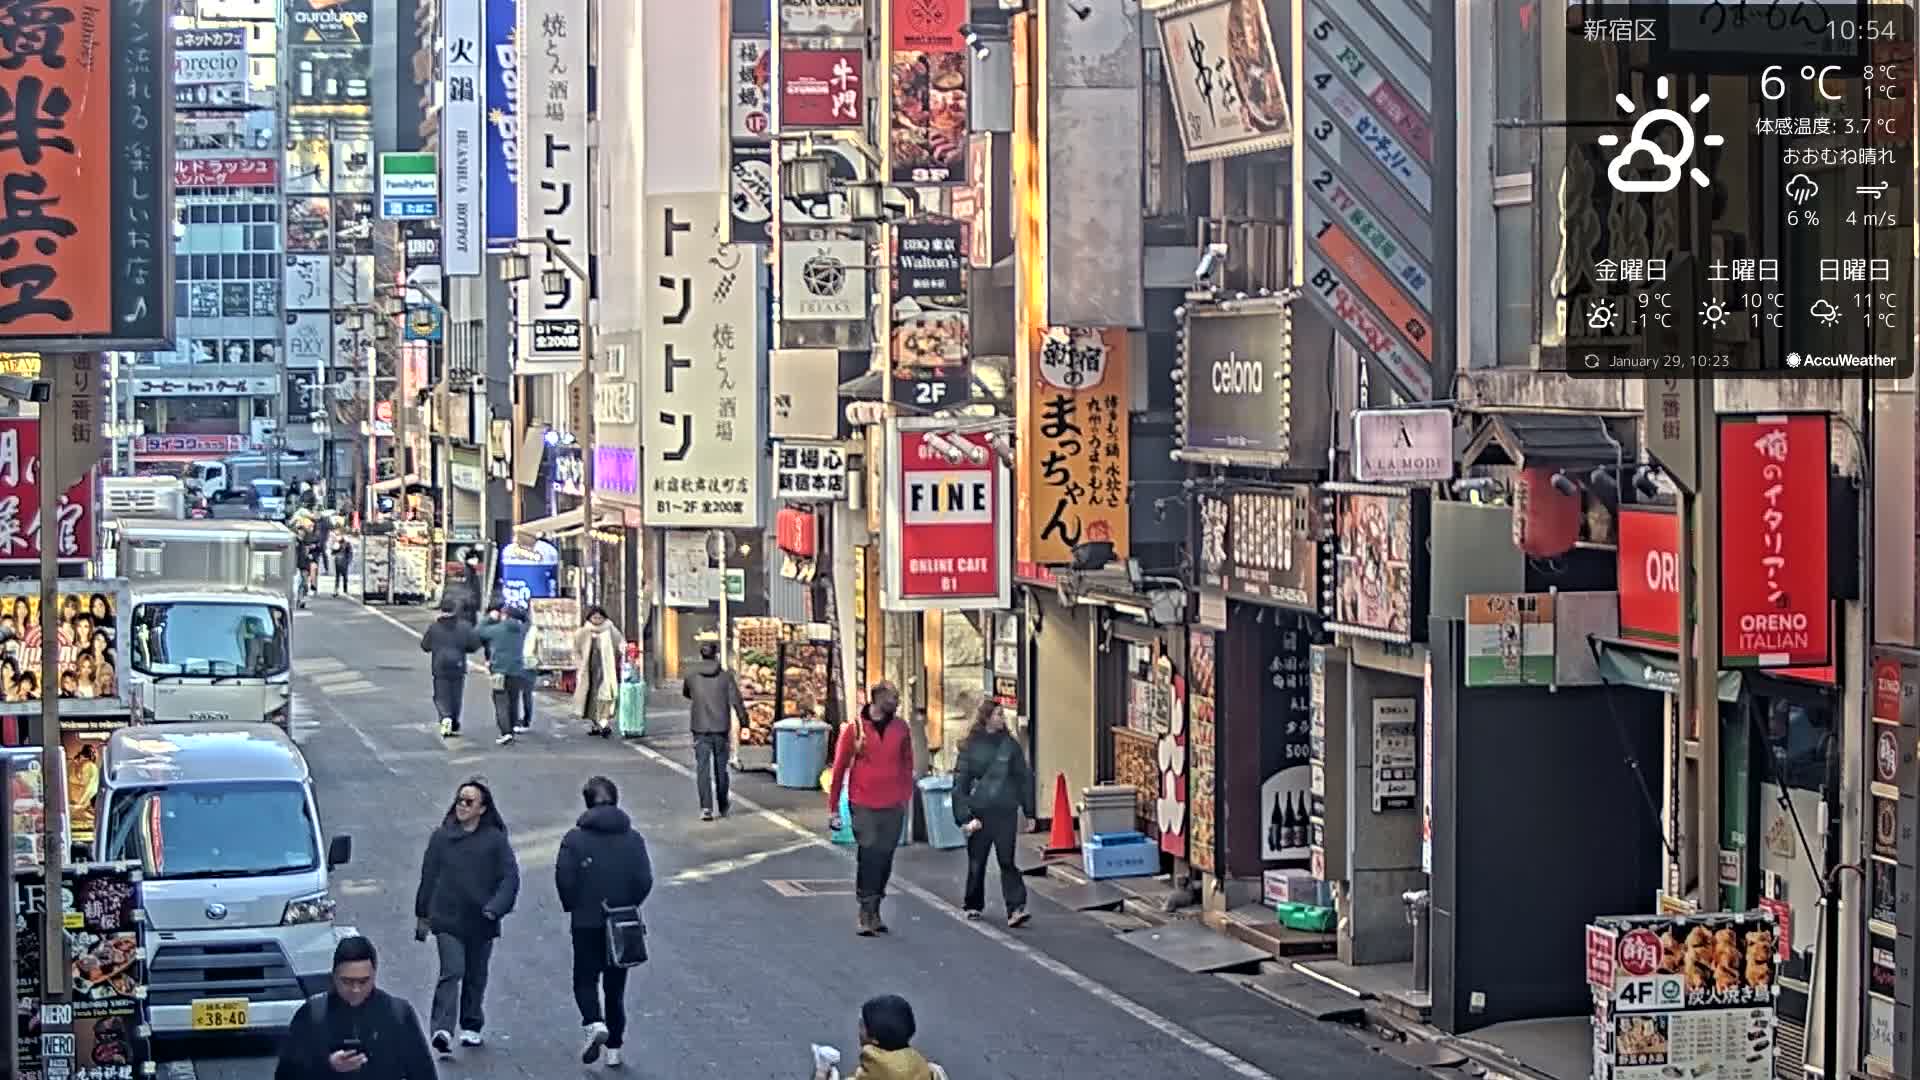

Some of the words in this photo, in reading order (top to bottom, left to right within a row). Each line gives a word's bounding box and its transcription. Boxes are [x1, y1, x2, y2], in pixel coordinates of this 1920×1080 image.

[1313, 20, 1335, 41] 5
[450, 37, 474, 102] 火鍋
[830, 57, 858, 119] 牛門
[1314, 73, 1332, 91] 4
[1314, 120, 1333, 140] 3
[1313, 171, 1333, 192] 2
[901, 254, 959, 269] Walton's
[1312, 268, 1339, 296] B1
[660, 208, 691, 461] トントン
[1043, 340, 1102, 373] 新宿
[712, 323, 737, 442] 焼とん酒場
[1063, 371, 1085, 387] の
[1212, 352, 1262, 394] celona
[140, 380, 185, 392] コーヒー
[916, 382, 947, 404] 2F
[1393, 421, 1414, 448] A
[779, 449, 843, 470] 酒場心
[1378, 458, 1396, 469] LA
[1041, 394, 1086, 548] まっちゃん
[779, 473, 843, 493] 新宿本店
[911, 484, 985, 511] FINE
[1754, 429, 1788, 603] 俺のイタリアン
[909, 558, 954, 575] ONLINE
[957, 557, 988, 574] CAFE
[1740, 614, 1807, 632] ORENO
[1739, 633, 1808, 650] ITALIAN
[1620, 982, 1653, 1004] 4F
[1687, 985, 1770, 1007] 炭火焼き鳥
[41, 1004, 72, 1024] NERO
[44, 1035, 73, 1056] NERO
